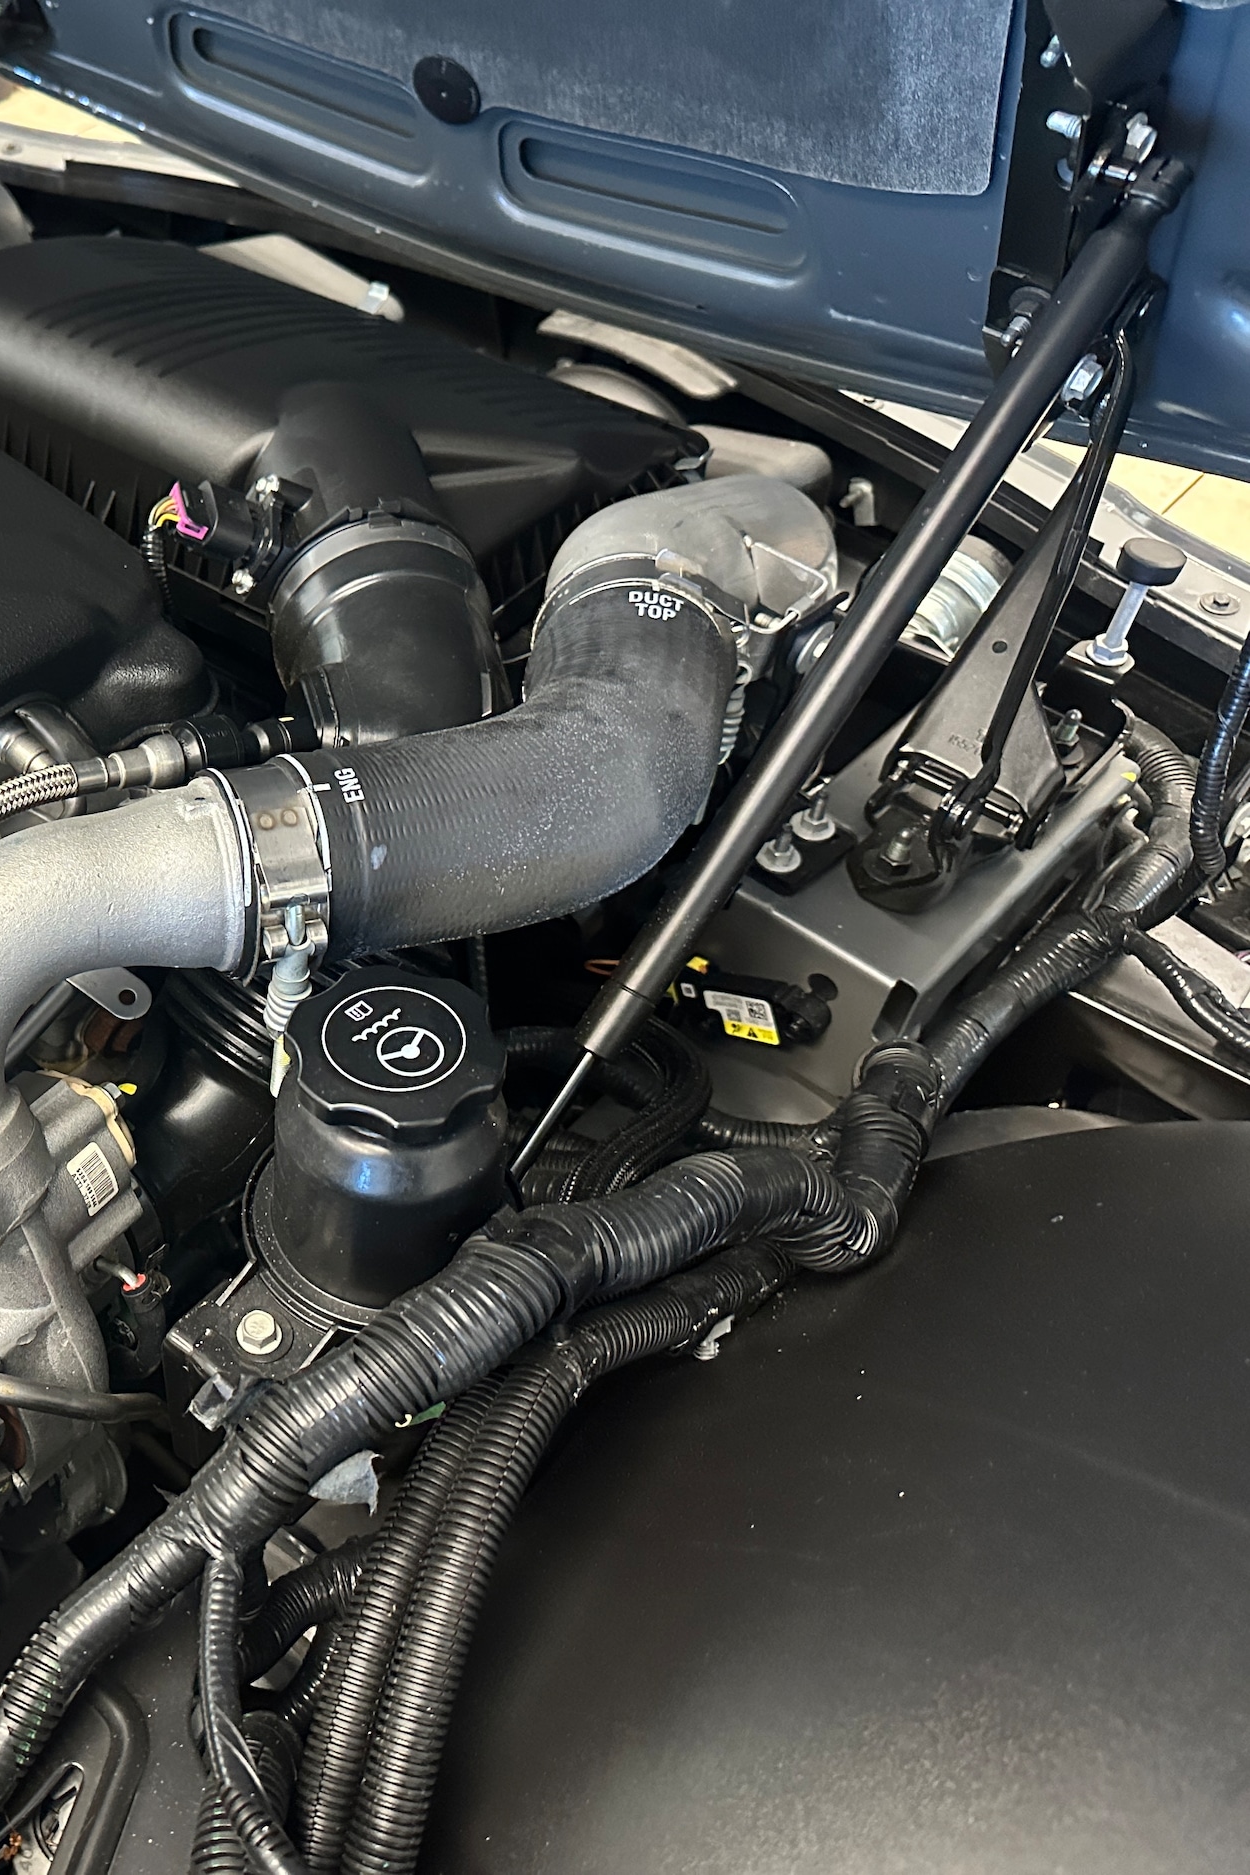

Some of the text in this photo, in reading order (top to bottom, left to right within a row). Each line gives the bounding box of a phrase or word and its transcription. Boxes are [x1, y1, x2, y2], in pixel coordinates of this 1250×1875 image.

[628, 590, 684, 611] DUCT
[635, 602, 677, 621] TOP
[333, 767, 365, 803] ENG
